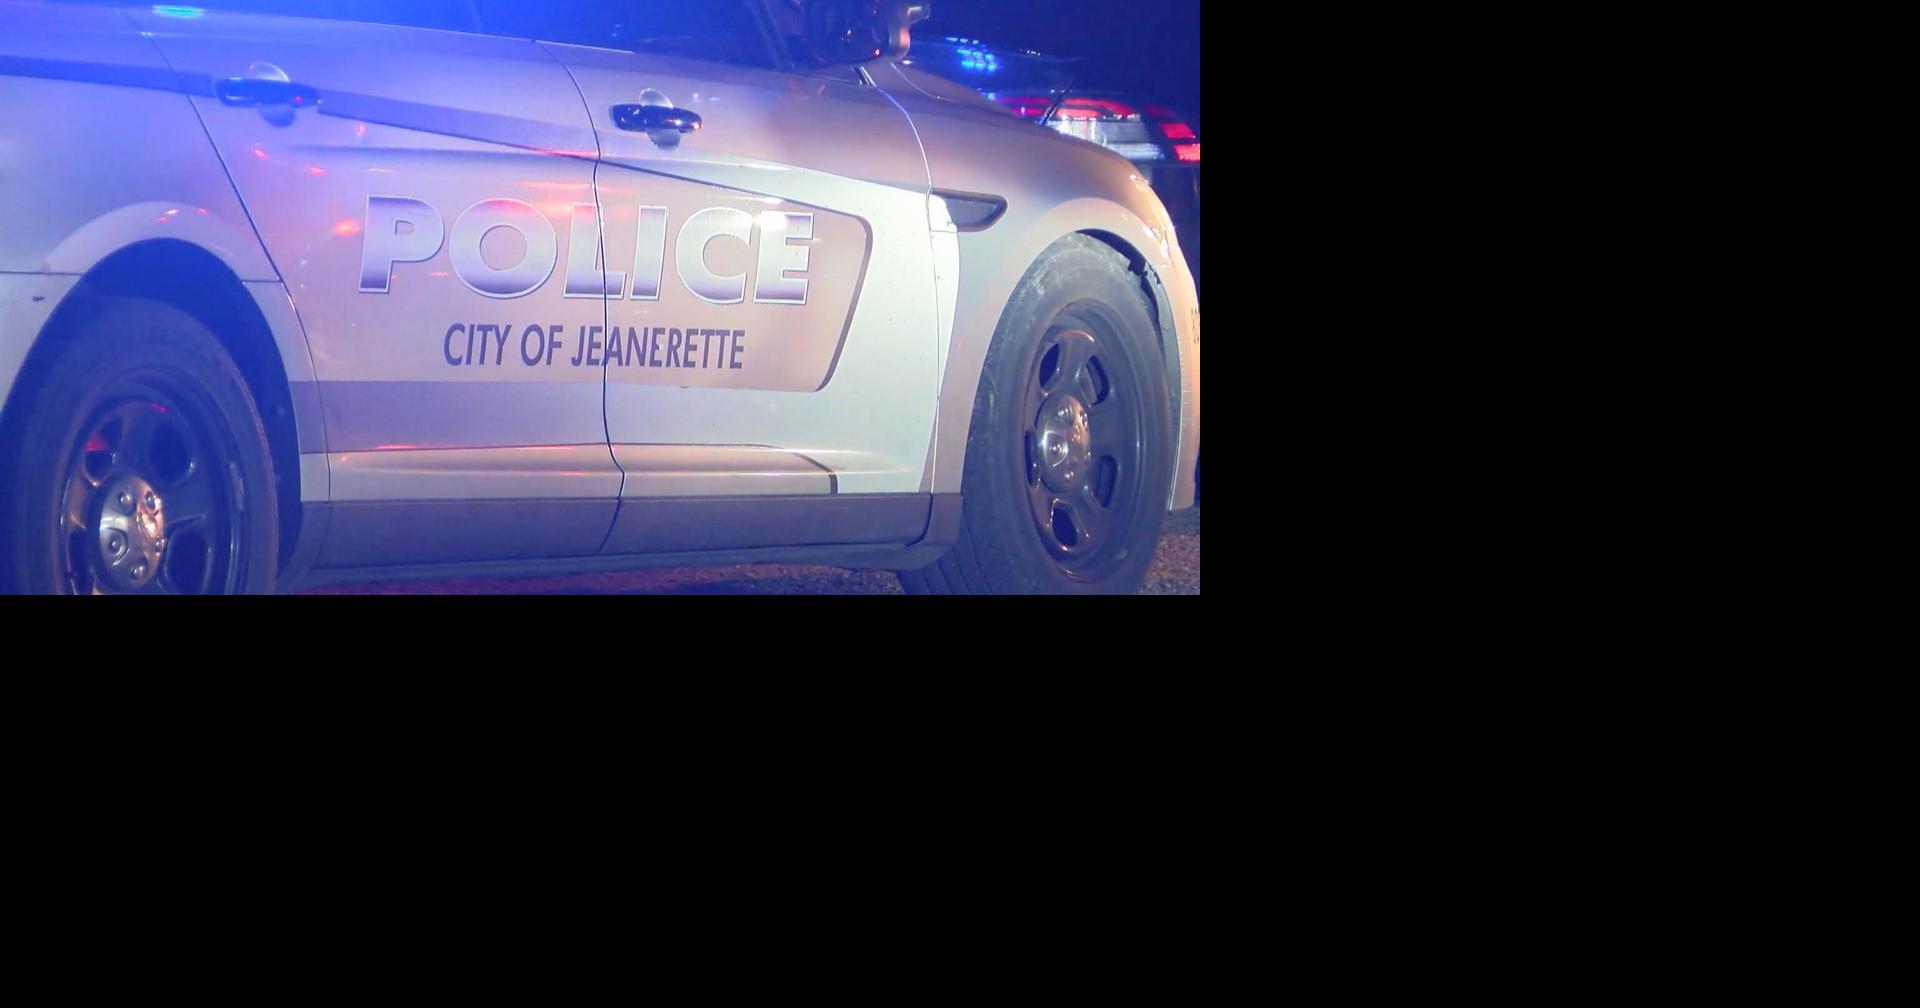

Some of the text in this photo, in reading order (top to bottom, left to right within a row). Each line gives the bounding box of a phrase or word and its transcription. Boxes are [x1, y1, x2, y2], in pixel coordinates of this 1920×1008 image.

[358, 194, 815, 305] POLICE
[443, 323, 746, 369] CITY OF JEANERETTE
